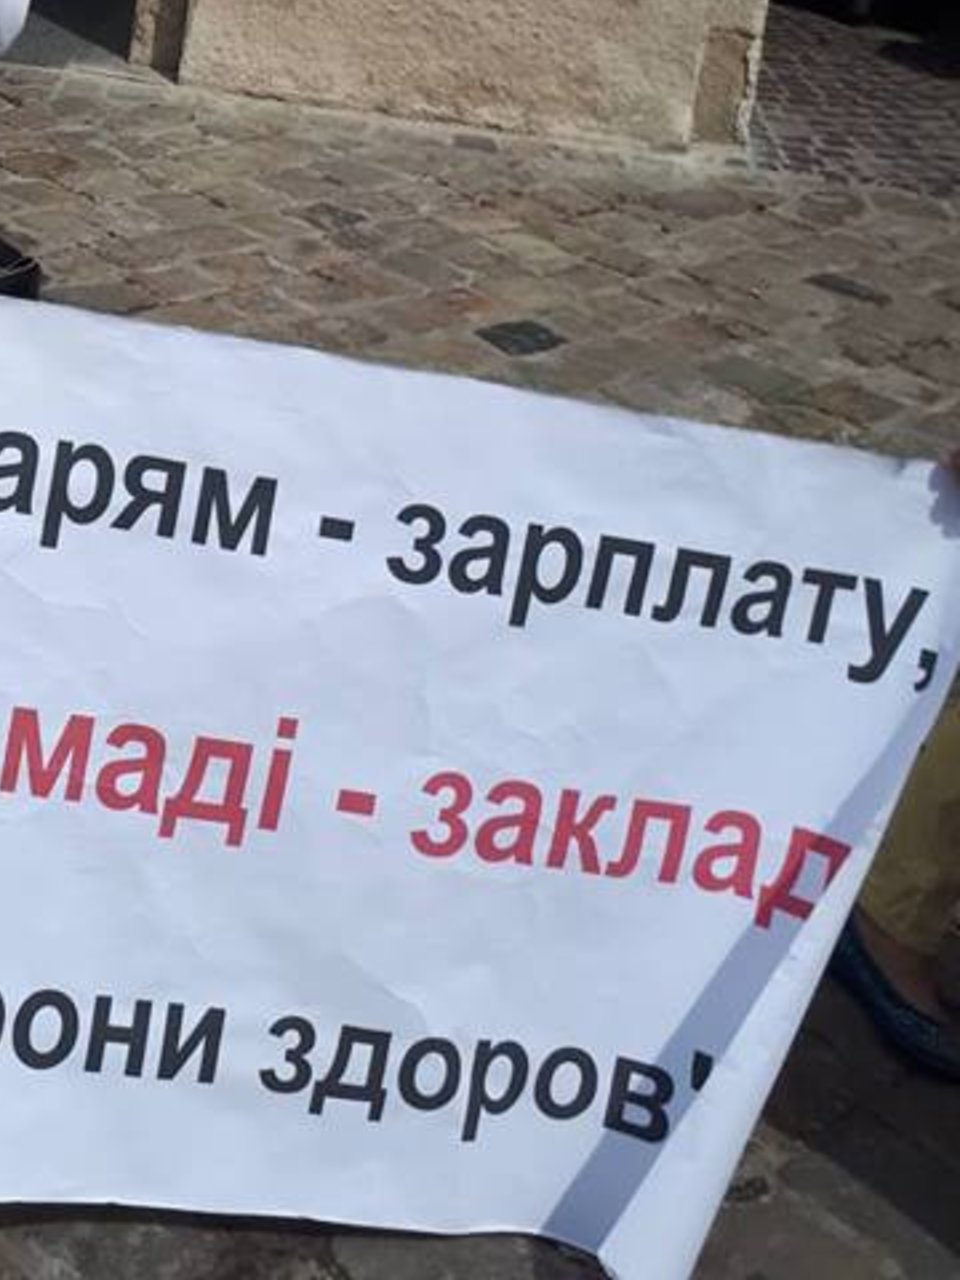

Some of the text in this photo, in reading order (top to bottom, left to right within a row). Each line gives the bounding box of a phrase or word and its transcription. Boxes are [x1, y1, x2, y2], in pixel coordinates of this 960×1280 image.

[319, 516, 355, 543] -
[386, 504, 939, 693] зарплату,
[338, 790, 375, 815] -
[410, 773, 852, 930] заклад
